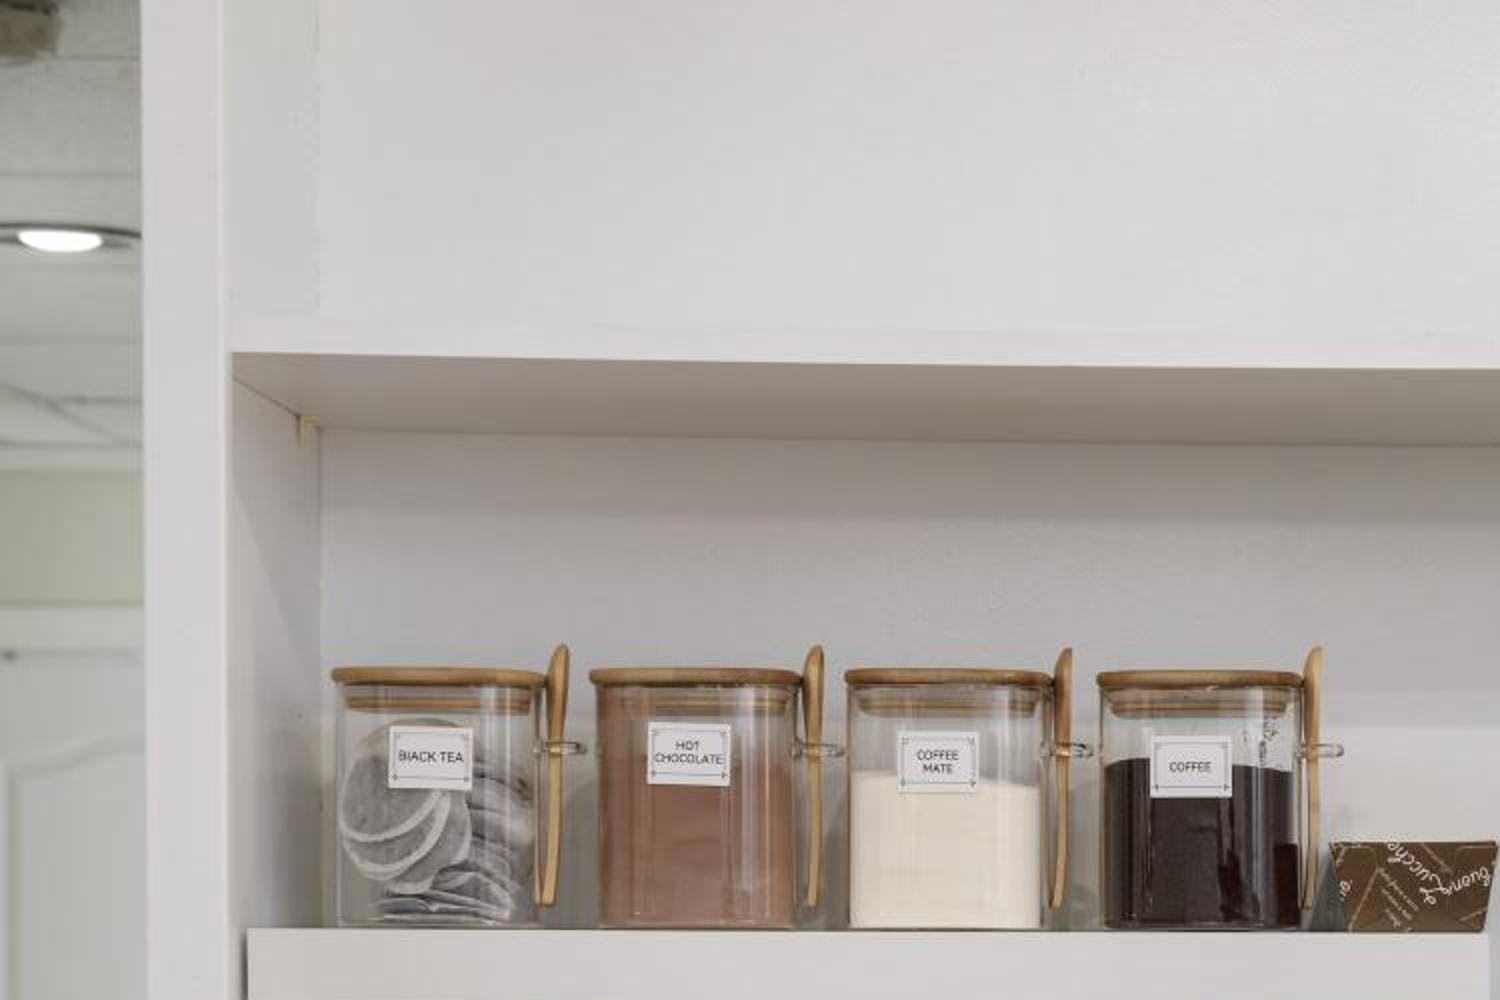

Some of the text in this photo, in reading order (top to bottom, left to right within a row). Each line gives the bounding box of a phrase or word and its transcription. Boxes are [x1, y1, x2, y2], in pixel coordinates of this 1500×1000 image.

[675, 740, 699, 751] HOT
[440, 751, 464, 762] TEA
[655, 752, 724, 764] CHOCOLATE
[916, 749, 959, 761] COFFEE
[923, 763, 953, 774] MATE
[1169, 761, 1212, 772] COFFEE
